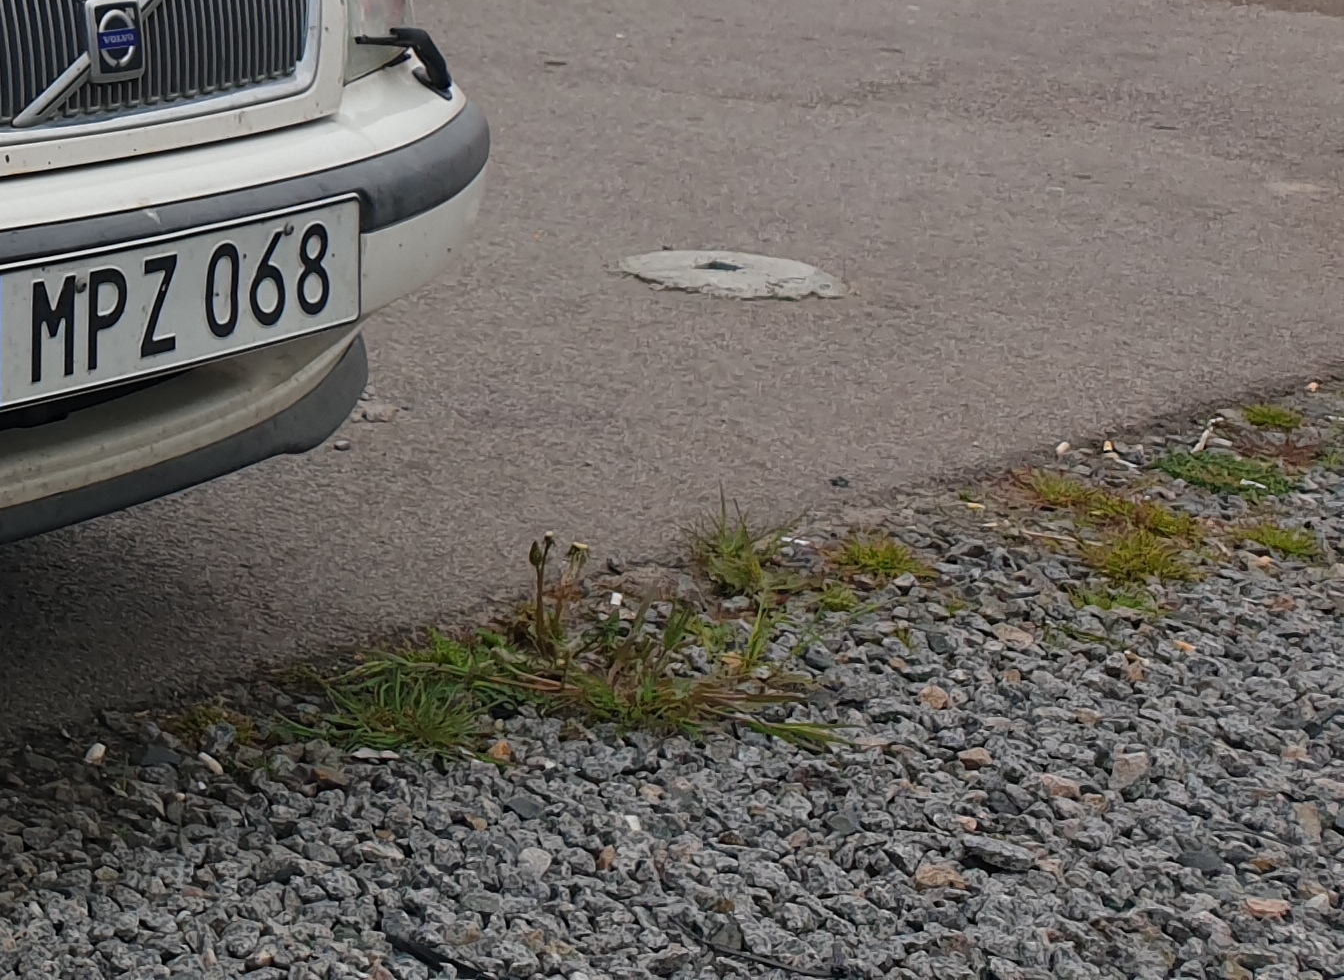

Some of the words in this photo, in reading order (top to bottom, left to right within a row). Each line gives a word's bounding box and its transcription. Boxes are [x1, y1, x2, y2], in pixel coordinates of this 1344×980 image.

[103, 33, 135, 44] VOLVO
[30, 253, 179, 384] MPZ
[204, 222, 331, 339] 068
